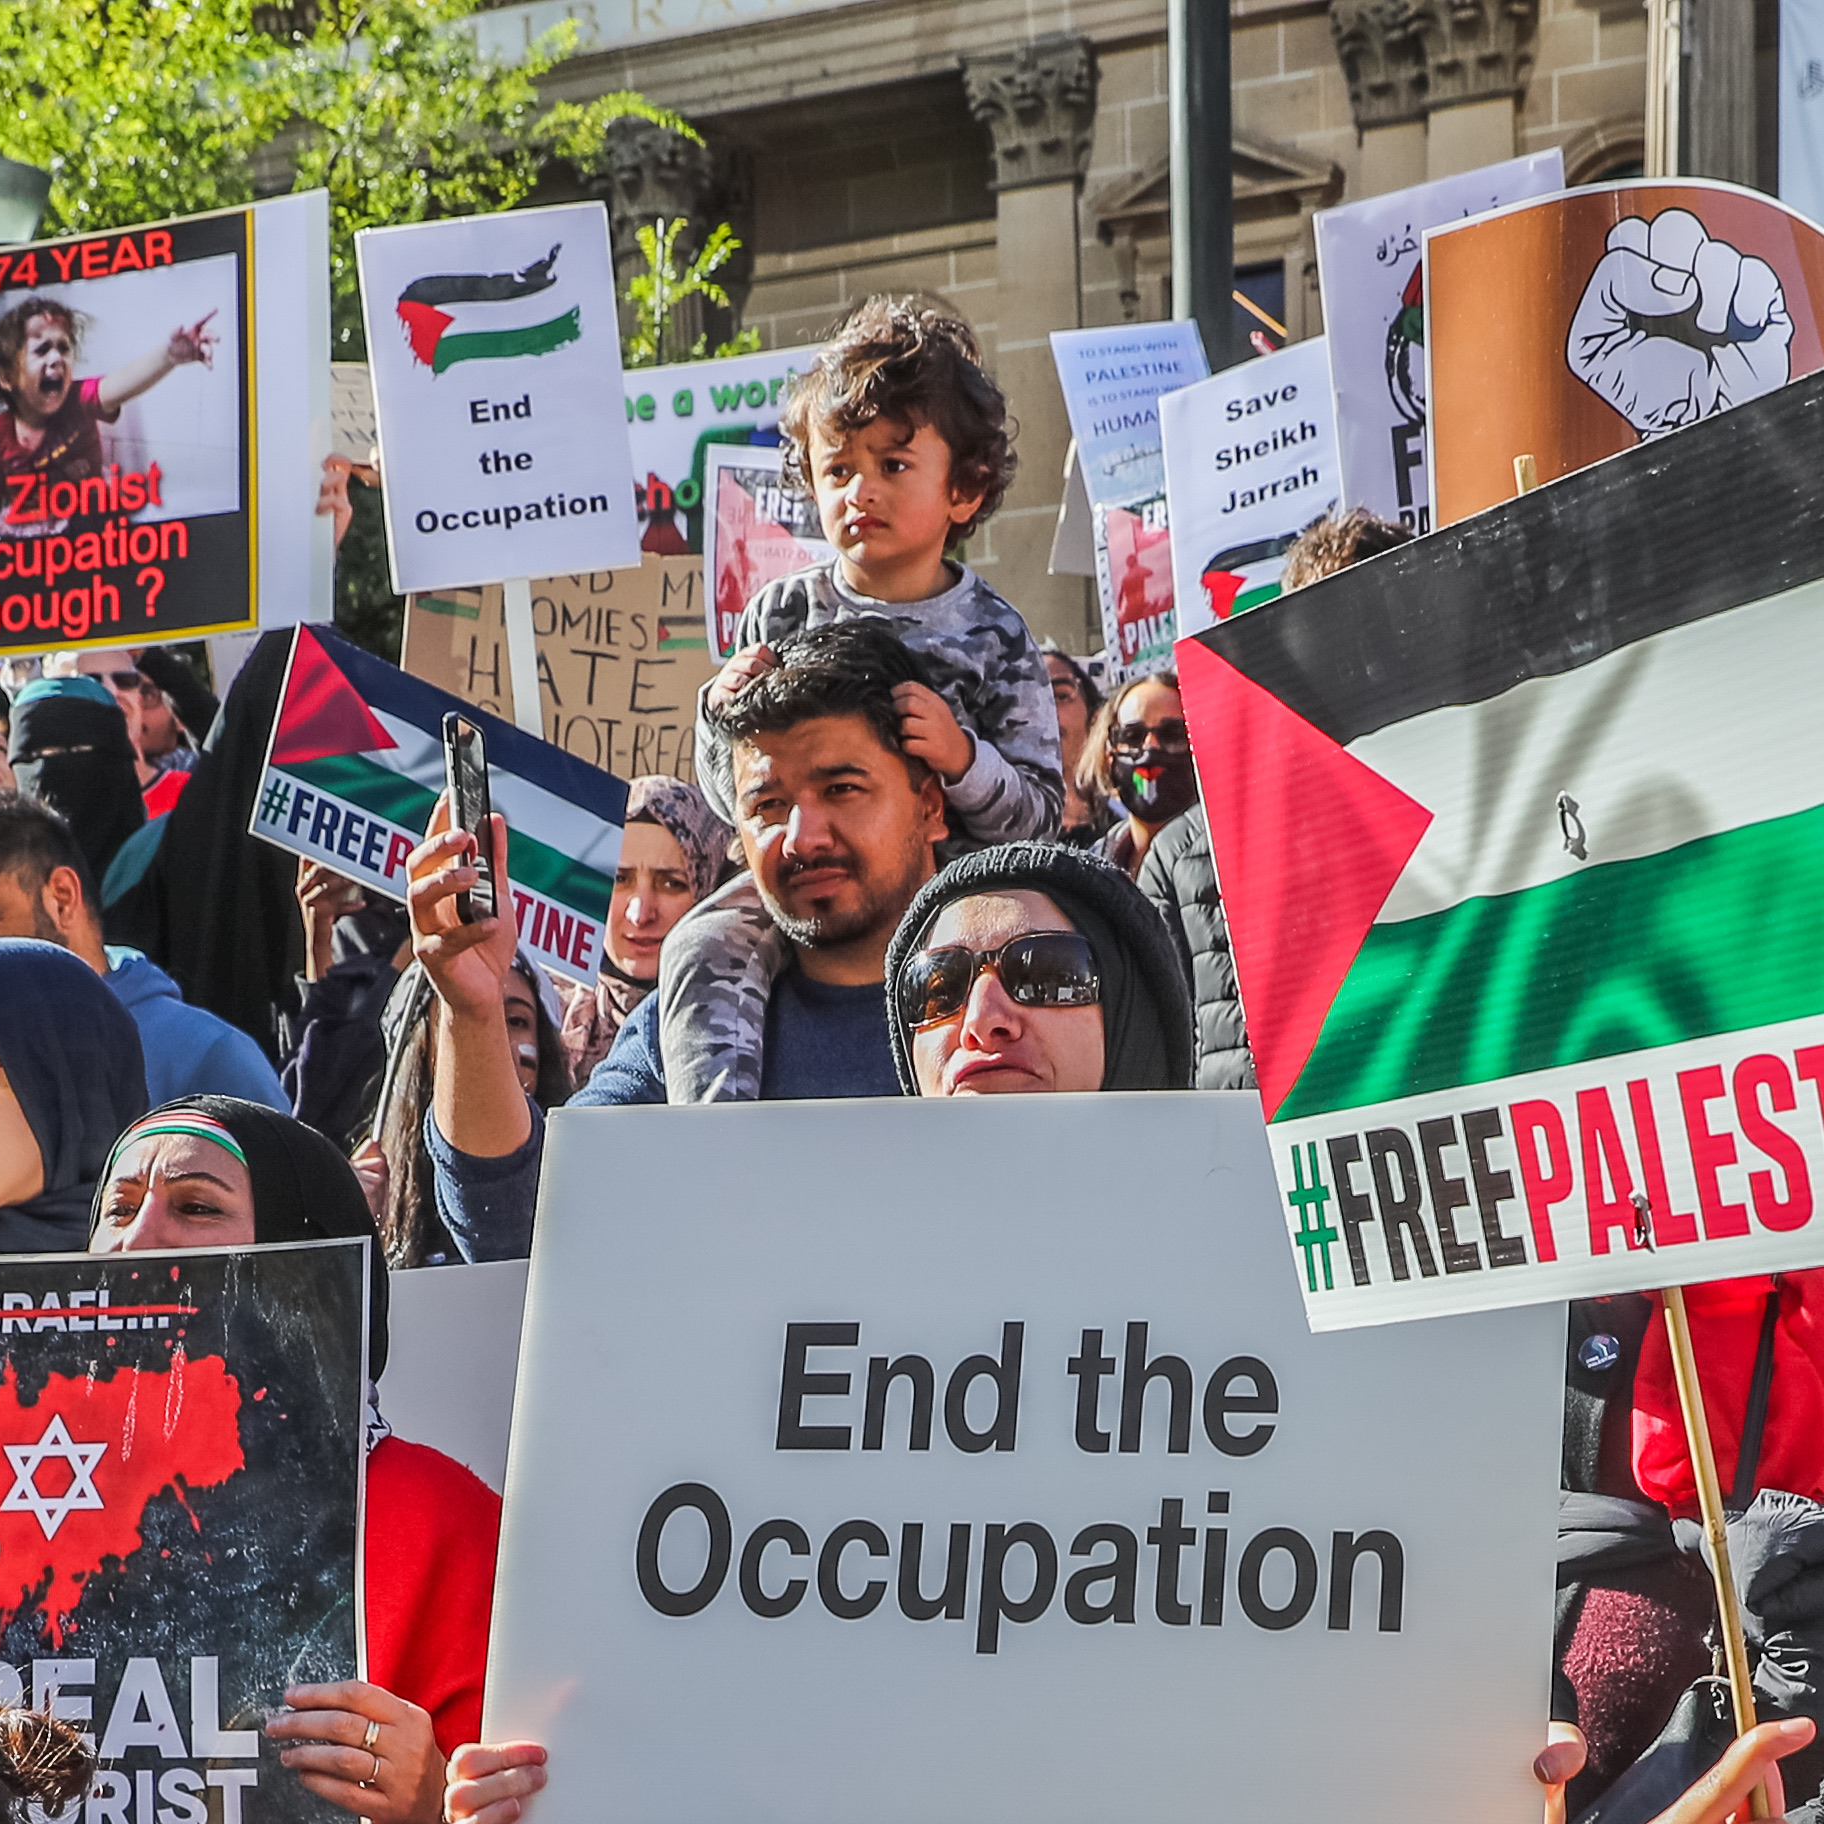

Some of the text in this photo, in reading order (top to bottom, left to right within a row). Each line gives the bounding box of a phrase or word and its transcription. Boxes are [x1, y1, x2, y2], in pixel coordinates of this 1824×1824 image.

[49, 230, 174, 282] YEAR
[1085, 359, 1184, 384] PALESTINE
[469, 395, 533, 424] End
[672, 388, 694, 418] a
[1092, 408, 1157, 437] HUMA
[1225, 383, 1298, 422] Save
[479, 446, 533, 474] the
[1214, 420, 1318, 471] Sheikh
[4, 461, 162, 525] Zionist
[414, 489, 610, 536] Occupation
[1220, 465, 1319, 514] Jarrah
[137, 565, 166, 617] ?
[500, 588, 648, 651] OMIES
[259, 776, 596, 972] #FREEPTINE
[775, 1320, 1281, 1458] End the
[634, 1480, 1406, 1656] Occupation
